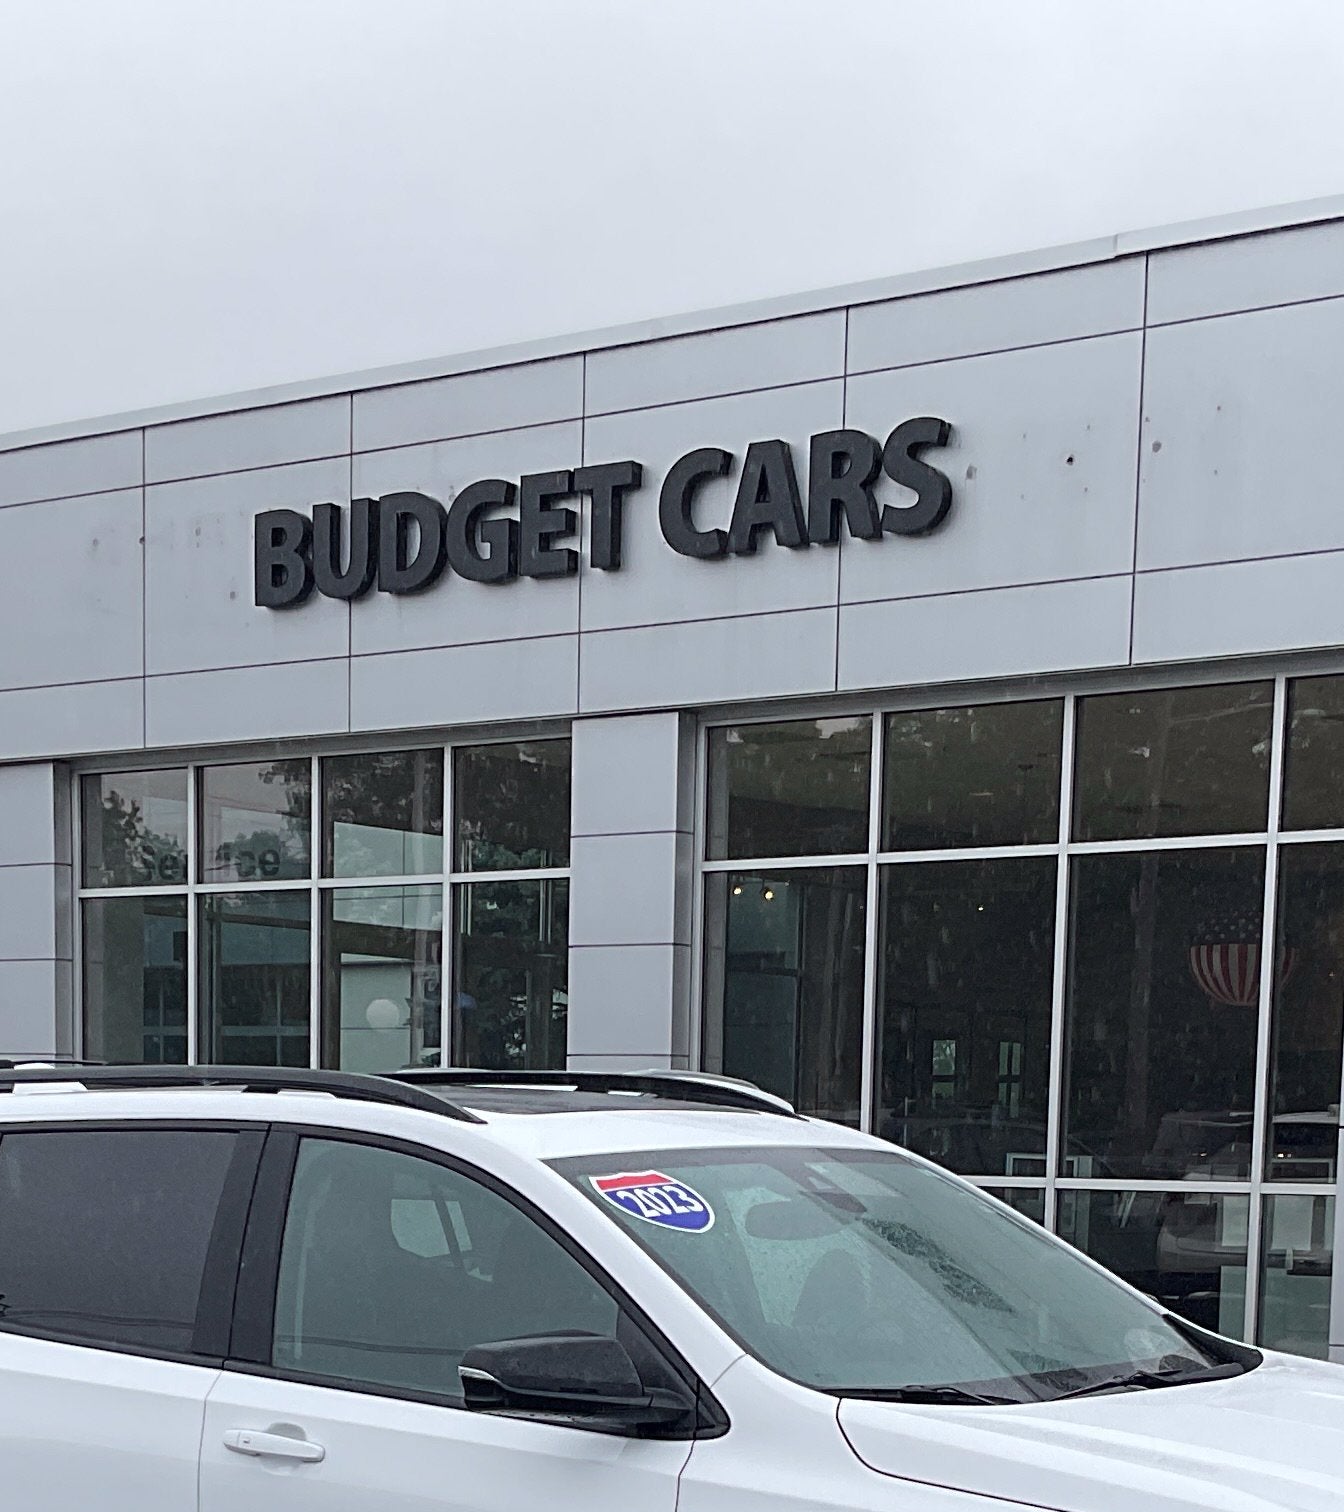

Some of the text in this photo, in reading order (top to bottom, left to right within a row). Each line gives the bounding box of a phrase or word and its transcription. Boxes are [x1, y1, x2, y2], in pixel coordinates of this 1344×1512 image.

[255, 416, 952, 609] BUDGET CARS
[616, 1185, 704, 1218] 2023
